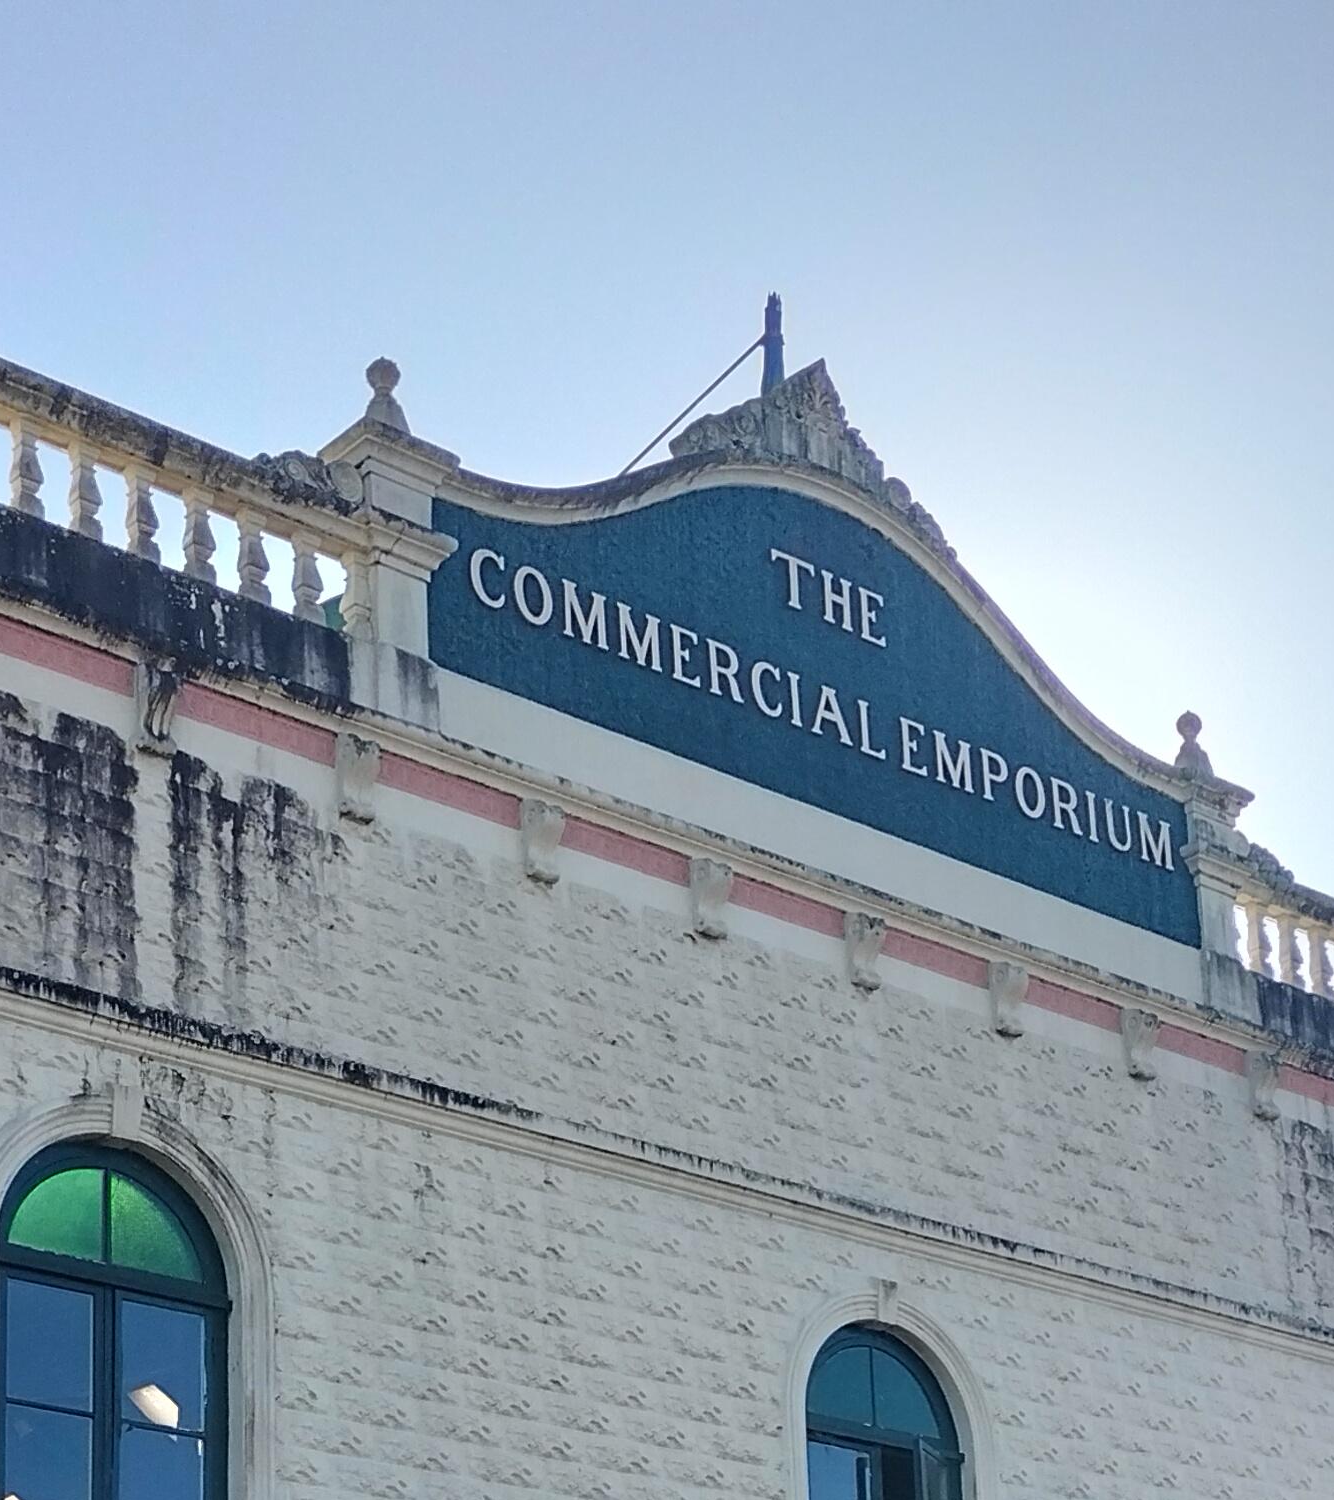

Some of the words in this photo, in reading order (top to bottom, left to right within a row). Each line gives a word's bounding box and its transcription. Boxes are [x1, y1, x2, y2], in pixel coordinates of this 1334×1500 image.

[771, 547, 887, 648] THE
[470, 548, 886, 760] COMMERCIAL
[900, 717, 1175, 872] EMPORIUM
